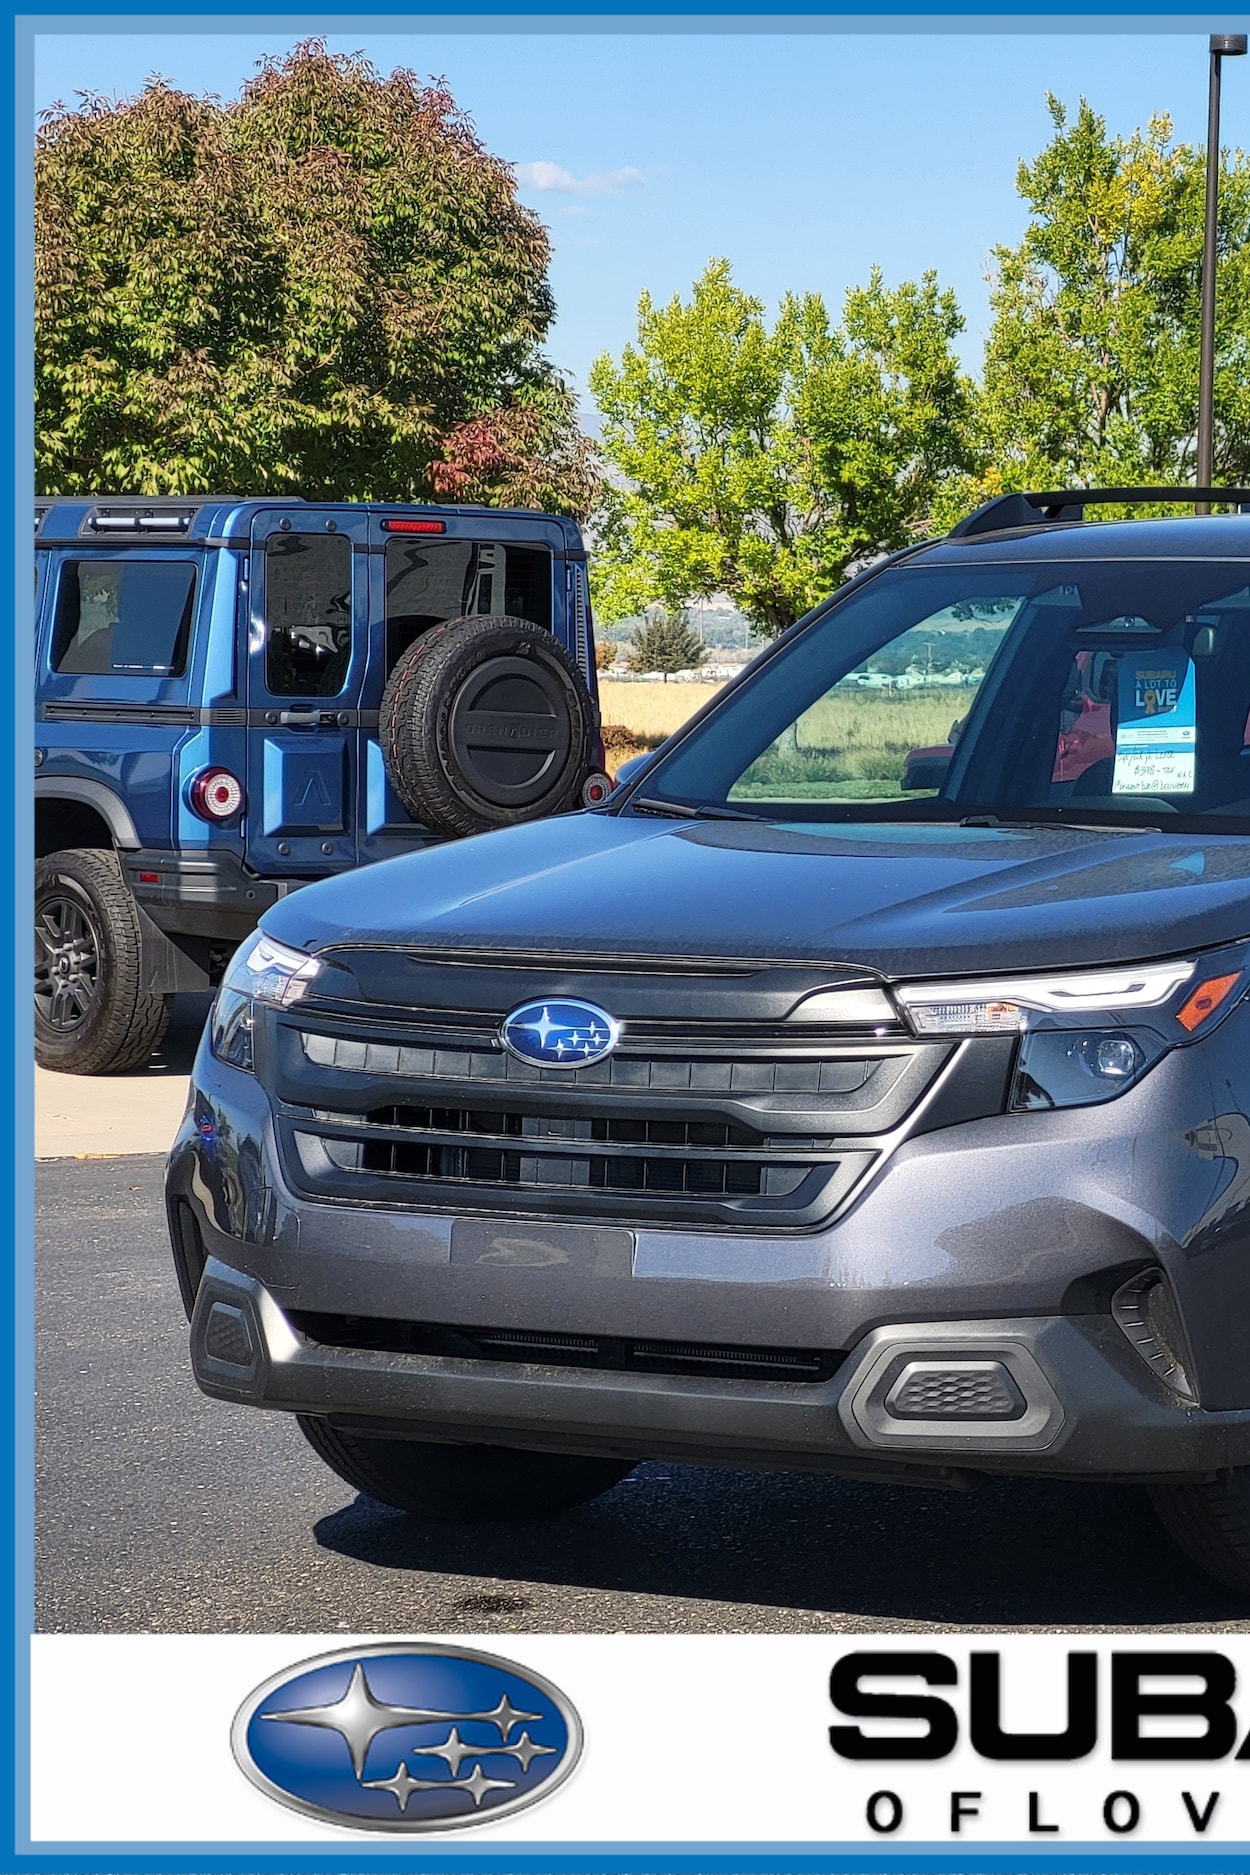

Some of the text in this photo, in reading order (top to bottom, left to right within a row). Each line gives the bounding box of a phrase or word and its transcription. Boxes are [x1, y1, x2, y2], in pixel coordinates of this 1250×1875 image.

[1136, 680, 1177, 689] A LOT TO
